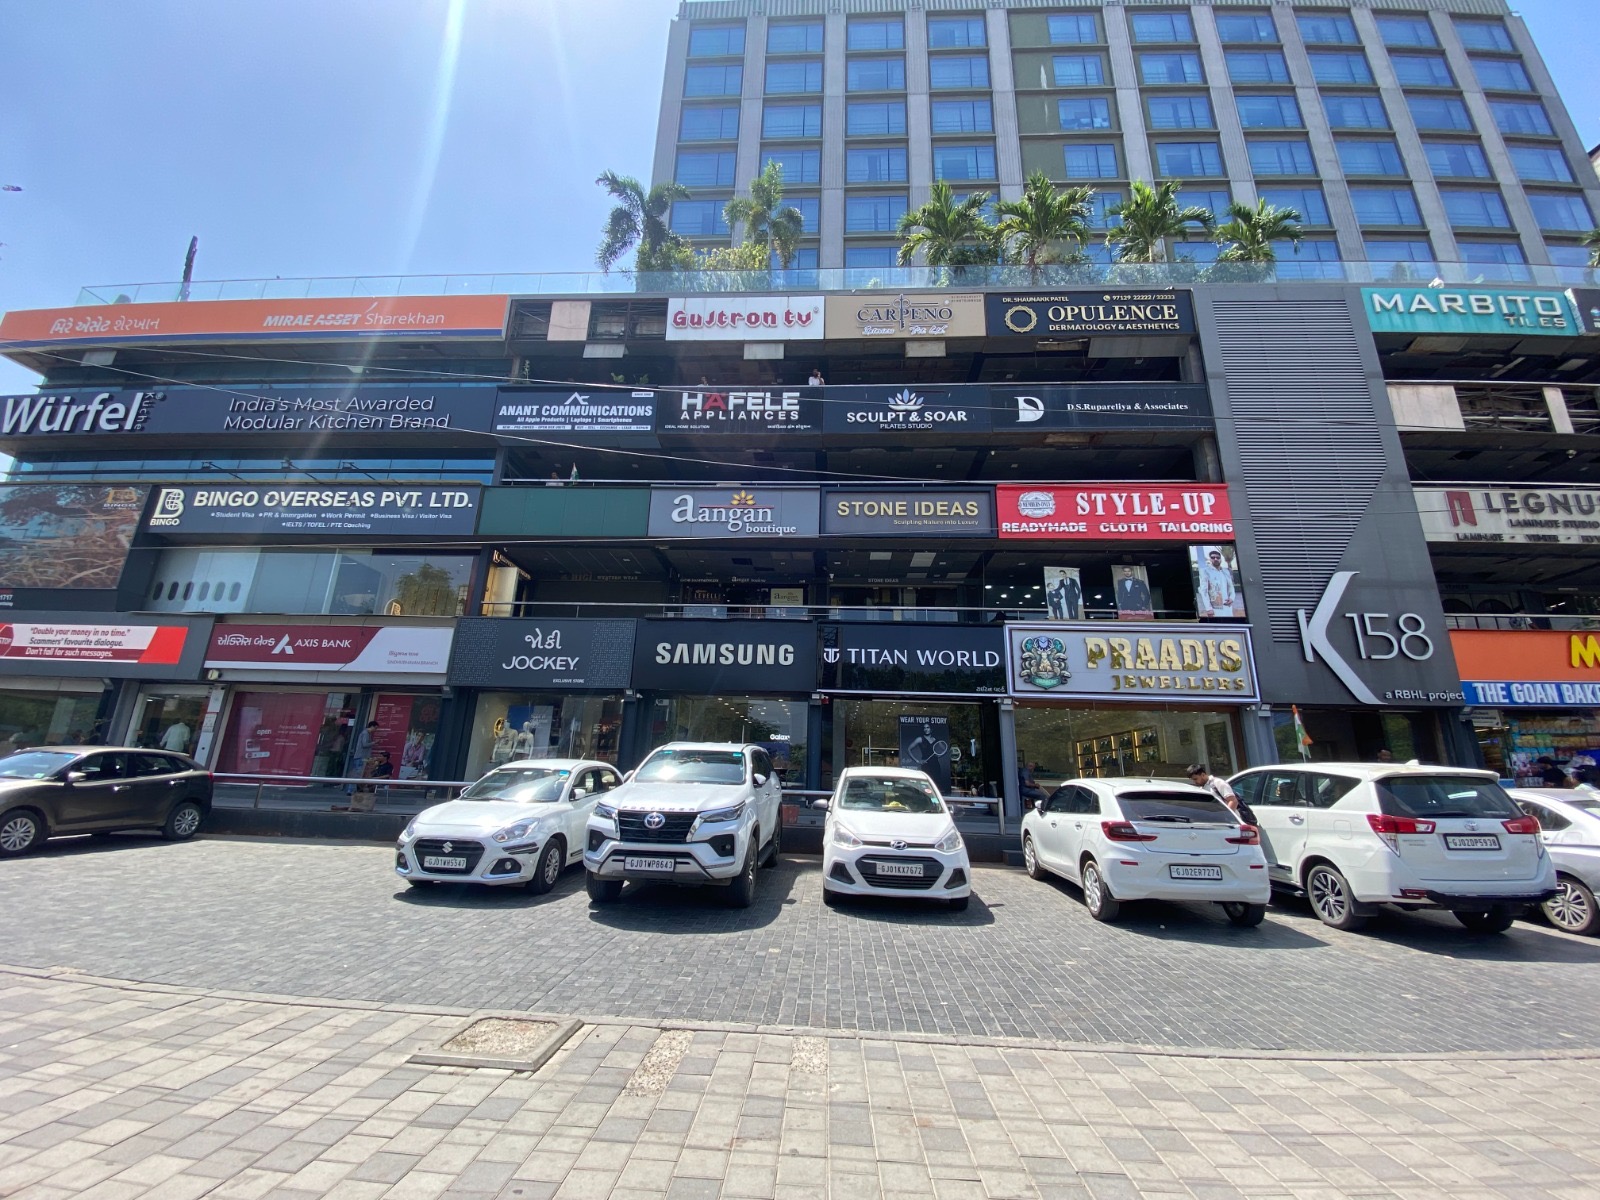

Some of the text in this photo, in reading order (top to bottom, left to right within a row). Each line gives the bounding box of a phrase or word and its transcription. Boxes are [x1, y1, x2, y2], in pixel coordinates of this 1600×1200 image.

[1371, 293, 1562, 316] MARBITO
[263, 311, 445, 327] MIRAE ASSET Sharekhan
[857, 307, 953, 322] CARPENO
[1047, 304, 1178, 321] OPULENCE
[1049, 323, 1117, 331] DERMATOLOGY
[1504, 316, 1567, 328] TILES
[229, 396, 435, 411] India's Most Awarded
[499, 405, 653, 417] ANANT COMMUNICATIONS
[1143, 402, 1189, 410] Associates
[2, 392, 144, 433] Würfel
[680, 411, 799, 420] APPLIANCES
[846, 410, 968, 423] SCULPT & SOAR
[223, 413, 450, 430] Modular Kitchen Brand
[193, 491, 473, 508] BINGO OVERSEAS PVT. LTD.
[1075, 492, 1216, 516] STYLE-UP
[1483, 492, 1600, 515] LEGNU
[671, 494, 773, 531] aangan
[837, 501, 979, 516] STONE IDEAS
[150, 518, 180, 526] BINGO
[1002, 522, 1233, 533] READYMADE CLOTH TAILORING
[1509, 519, 1600, 529] LAMINATE STUDIO
[745, 524, 797, 536] boutique
[55, 629, 70, 637] your
[70, 629, 92, 637] money
[93, 628, 100, 636] in
[63, 638, 93, 646] favourite
[94, 639, 123, 648] dialogue.
[294, 638, 352, 648] AXIS BANK
[25, 647, 42, 655] Don't
[54, 648, 64, 656] for
[64, 648, 79, 656] such
[80, 650, 113, 658] messages.
[655, 642, 794, 666] SAMSUNG
[847, 648, 1000, 667] TITAN WORLD
[1084, 637, 1243, 672] PRAADIS
[502, 656, 579, 670] JOCKEY
[1112, 674, 1246, 691] JEWELLERS
[1385, 689, 1466, 702] a RBHL project
[1472, 682, 1509, 703] THE
[1510, 683, 1560, 704] GOAN
